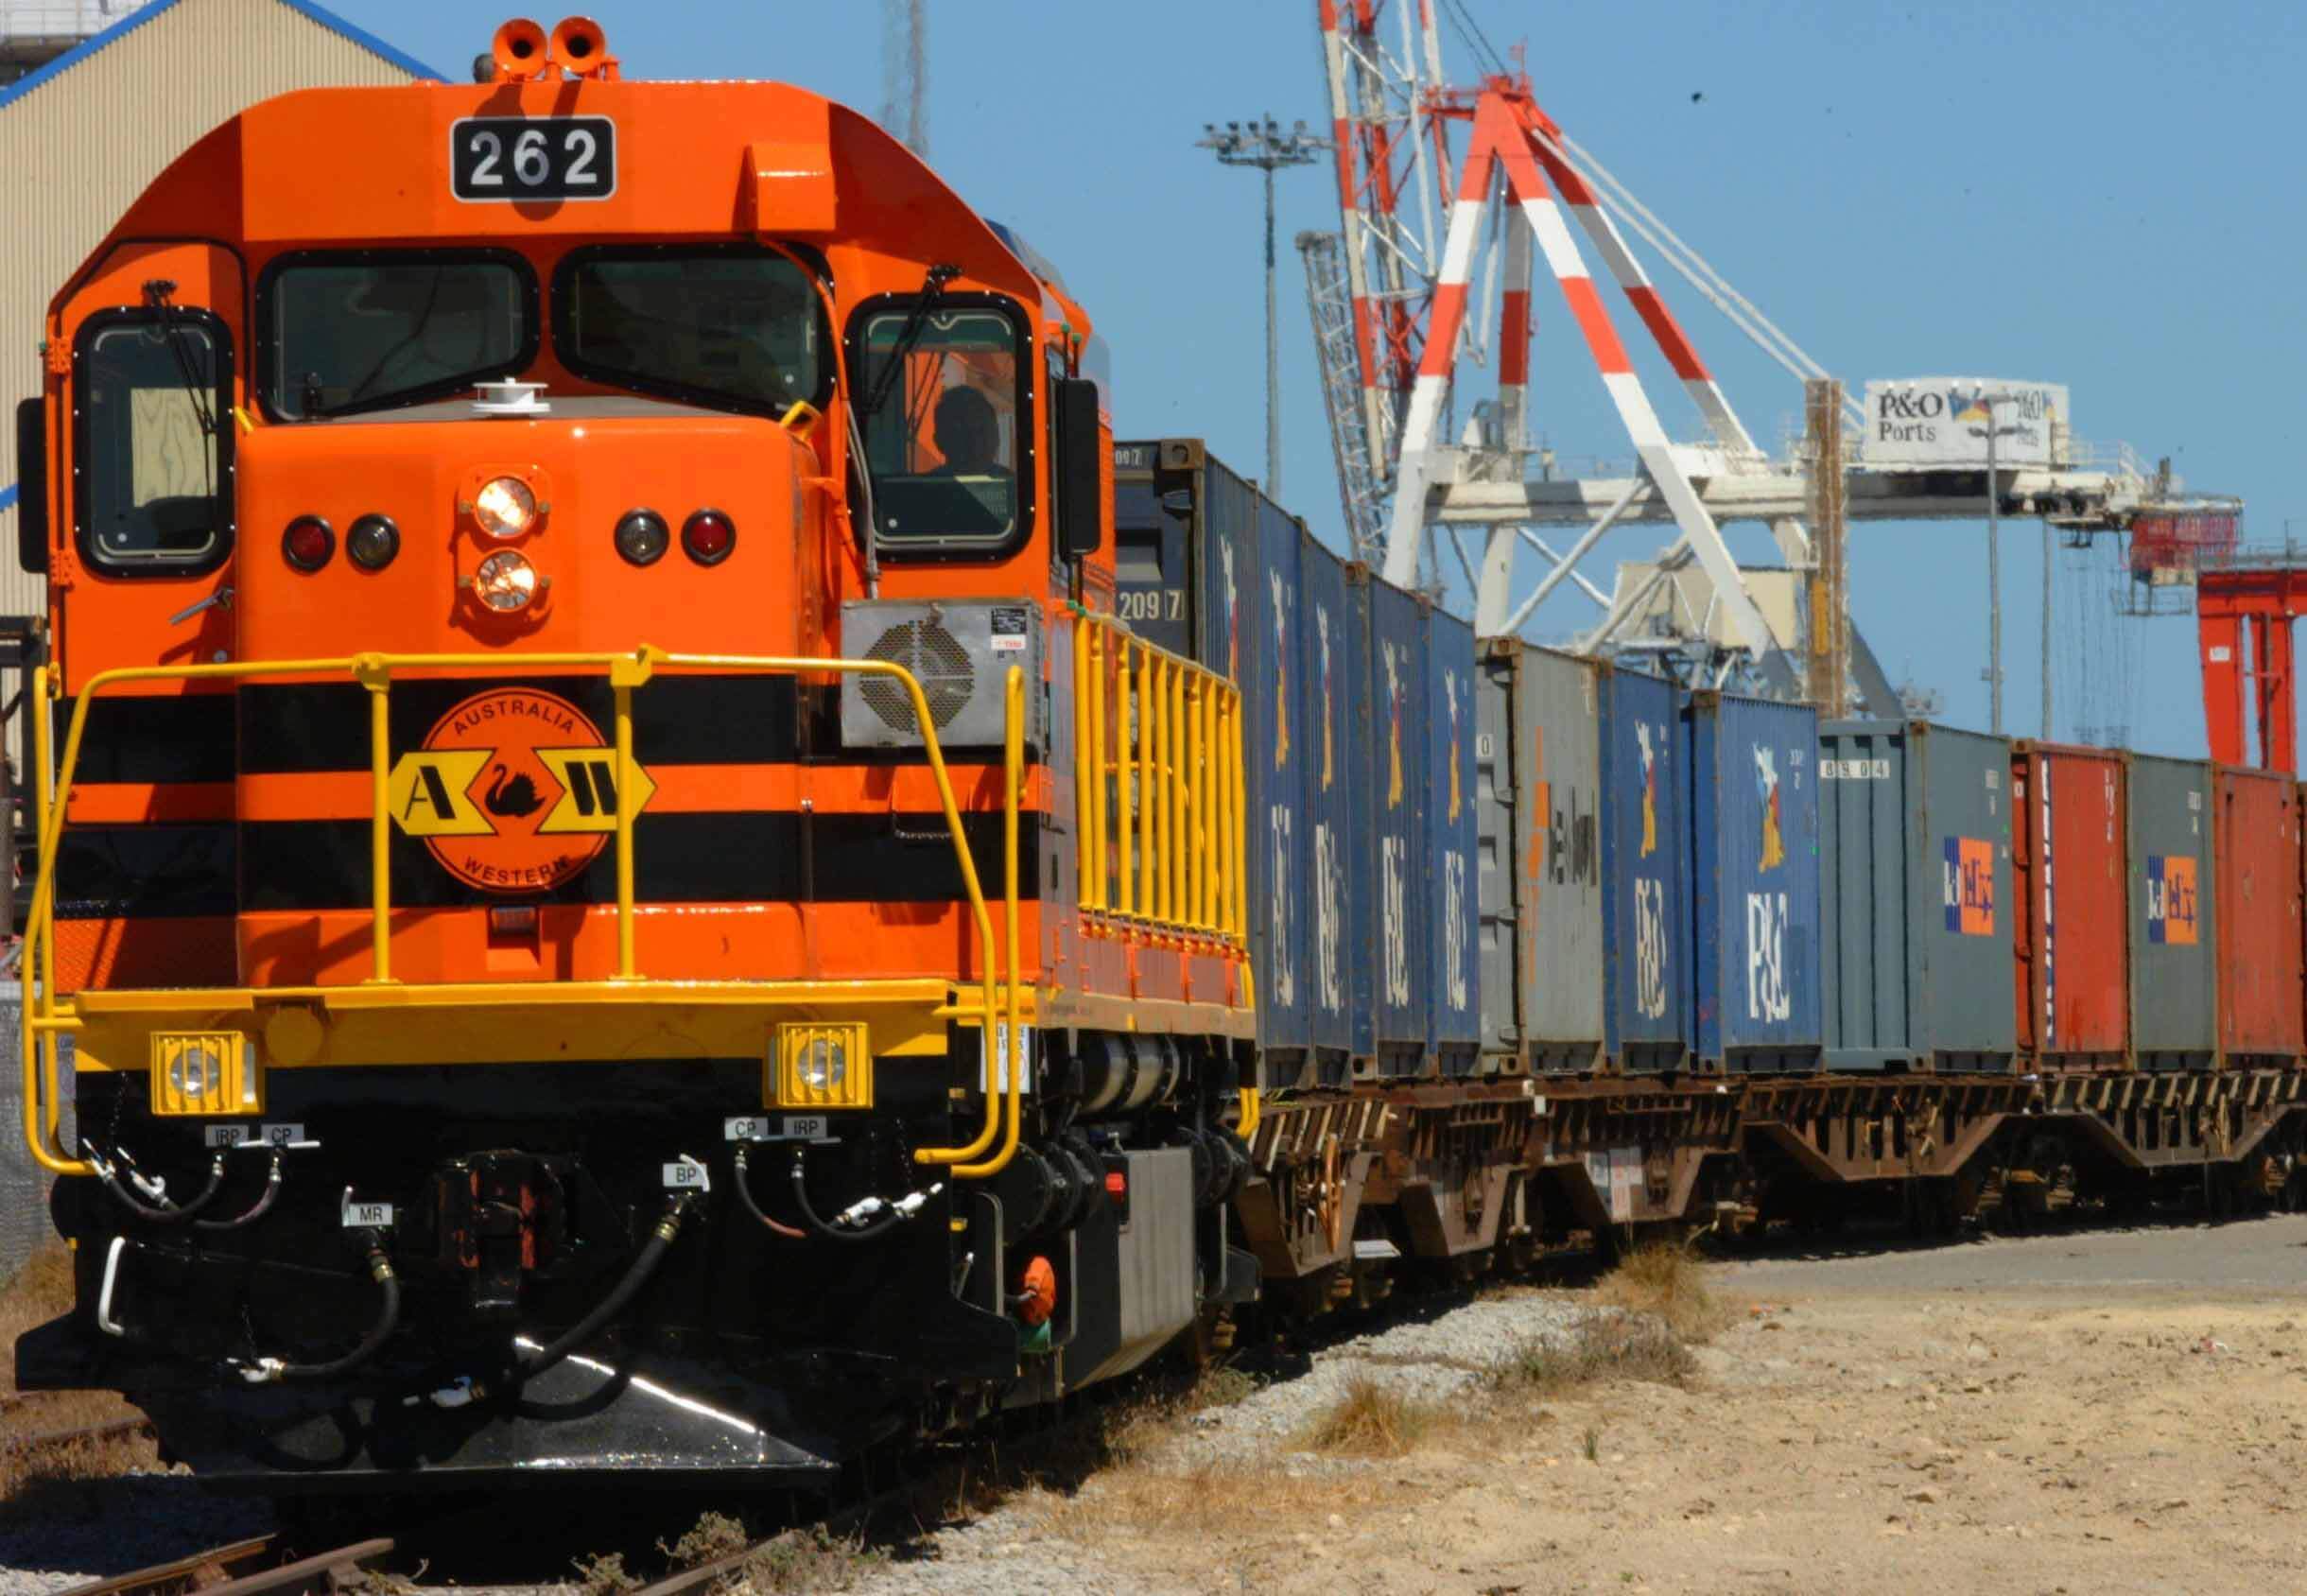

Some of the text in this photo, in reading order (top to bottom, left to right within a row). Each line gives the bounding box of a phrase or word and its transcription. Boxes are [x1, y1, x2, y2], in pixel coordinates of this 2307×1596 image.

[470, 129, 598, 186] 262
[1879, 391, 1944, 419] P&O
[1879, 422, 1937, 442] Ports
[453, 700, 575, 736] AUSTRALIA
[464, 855, 570, 885] WESTERN
[215, 1128, 242, 1145] IRP
[271, 1126, 293, 1144] CP
[735, 1120, 756, 1136] CP
[793, 1119, 820, 1136] IRP
[676, 1167, 697, 1183] BP
[359, 1206, 384, 1223] MR
